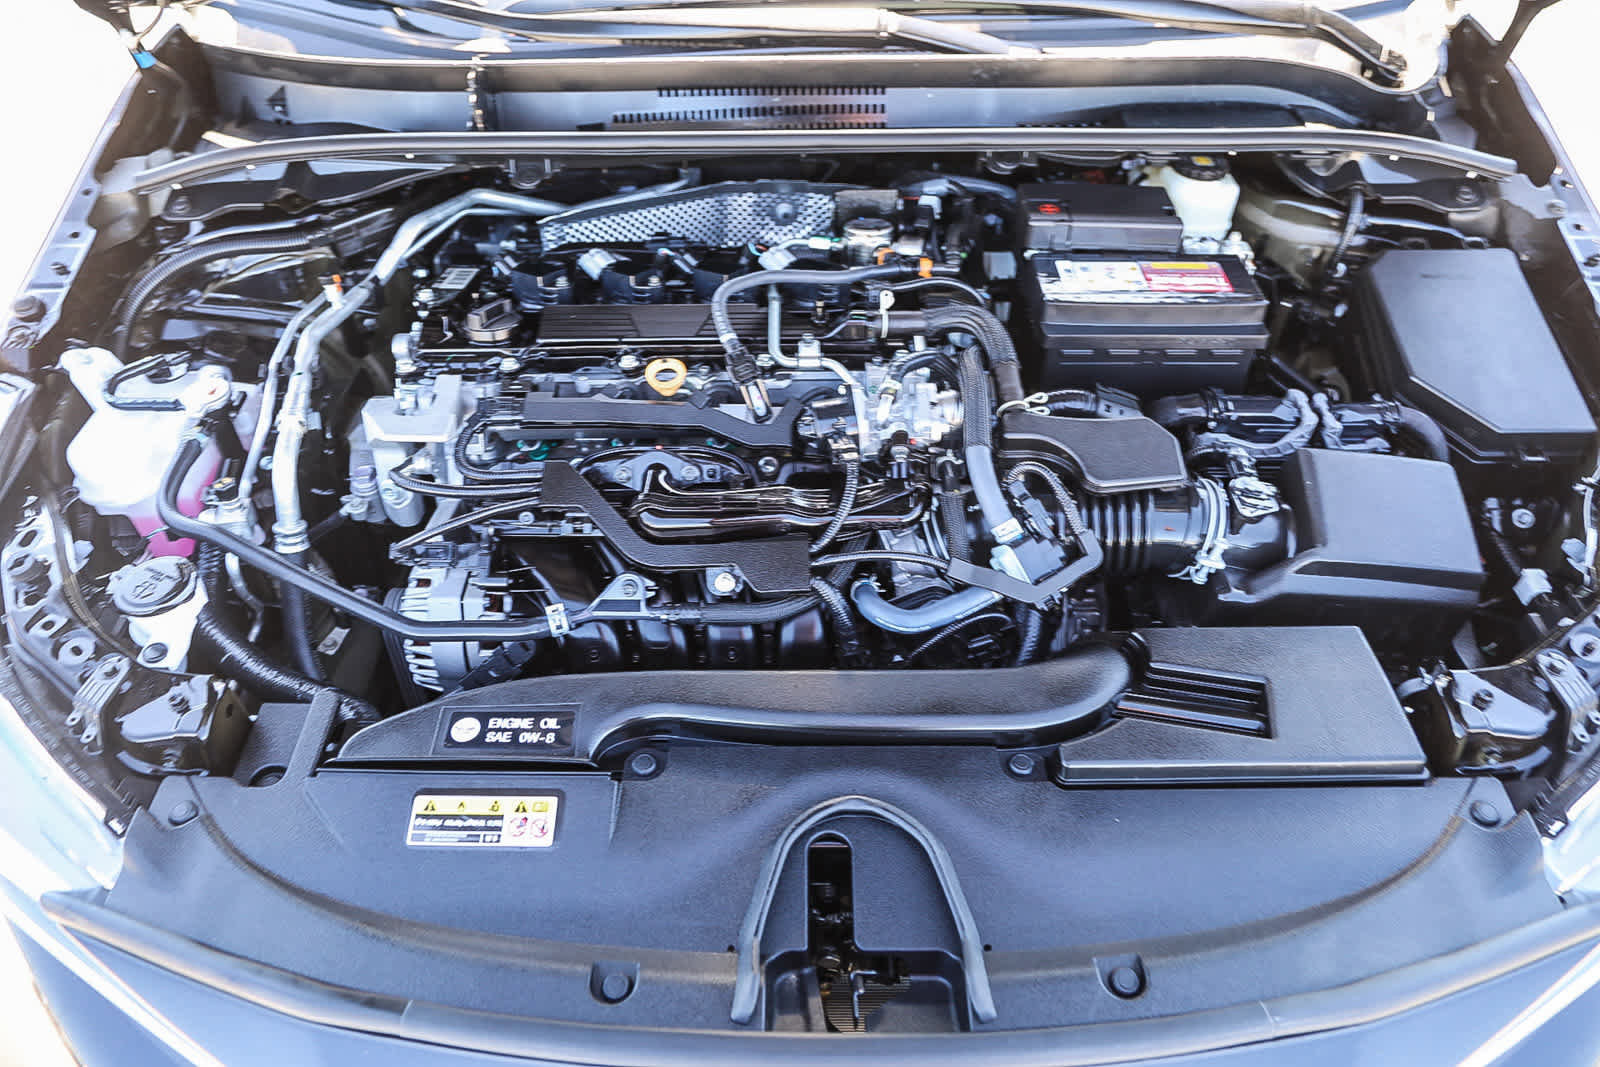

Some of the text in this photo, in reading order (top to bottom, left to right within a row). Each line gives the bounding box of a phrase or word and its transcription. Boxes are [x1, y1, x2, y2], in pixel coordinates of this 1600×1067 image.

[487, 717, 561, 729] ENGINE OIL
[485, 731, 556, 744] SAE 0W-8
